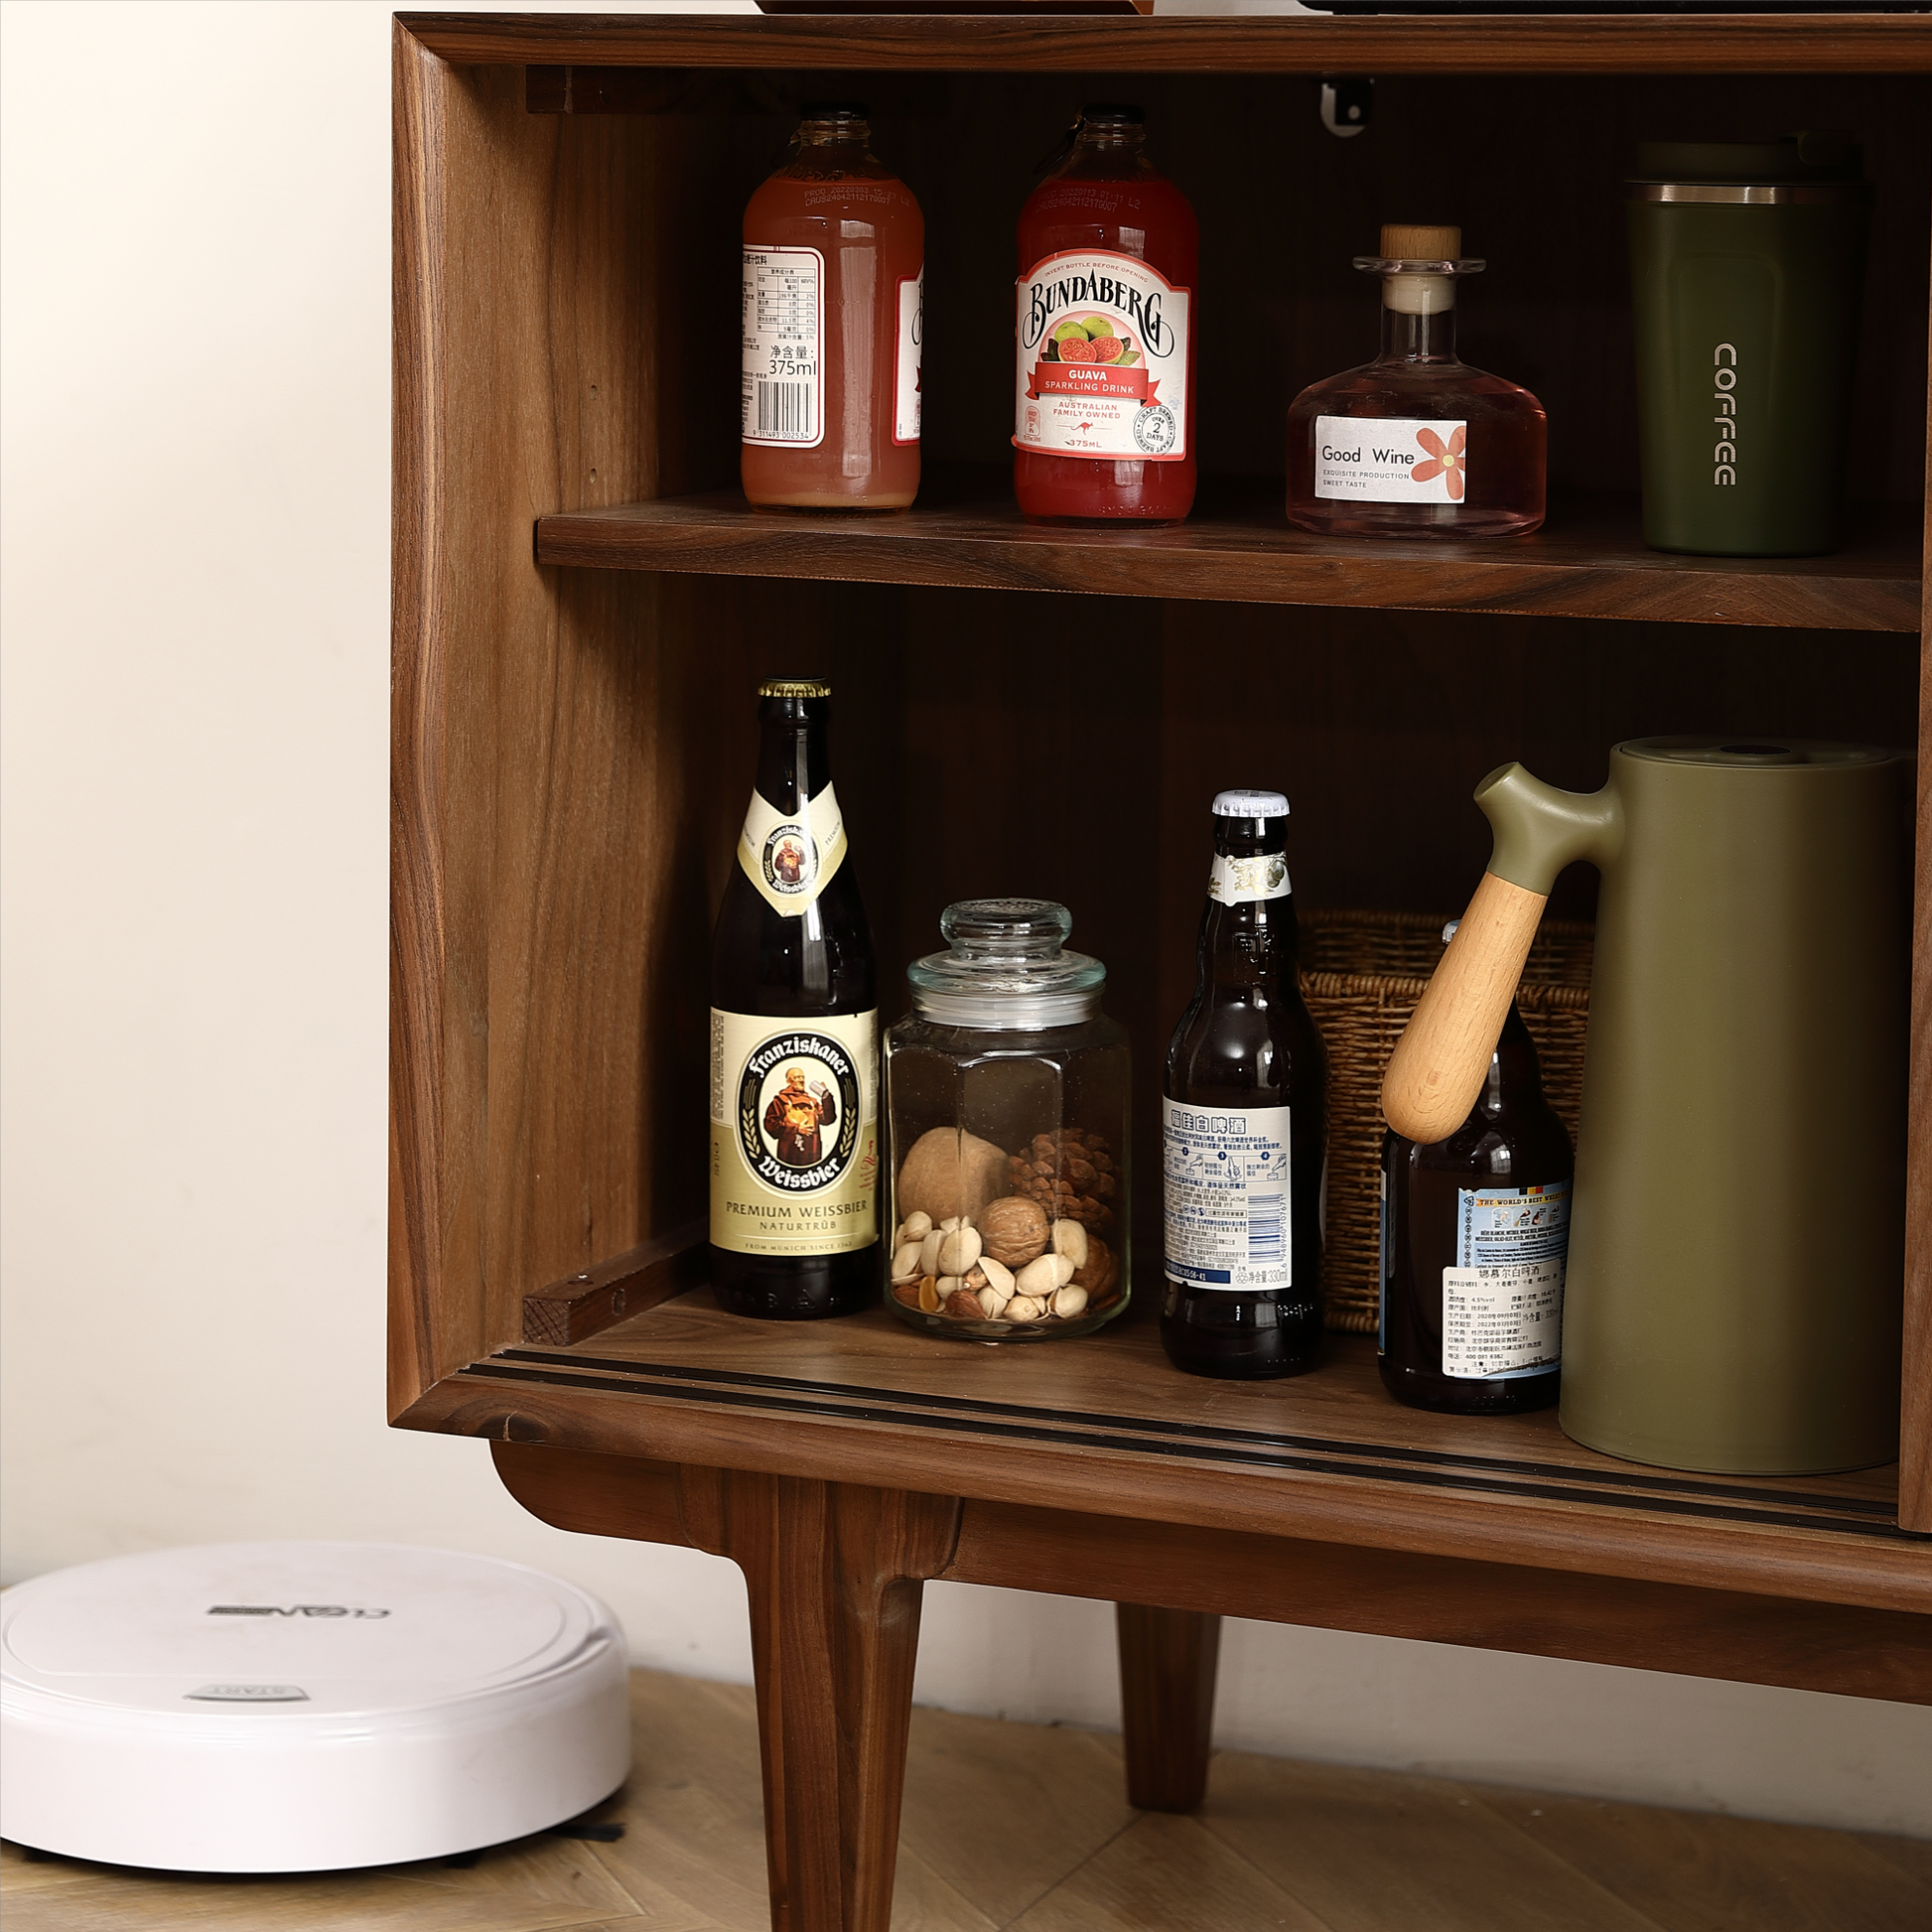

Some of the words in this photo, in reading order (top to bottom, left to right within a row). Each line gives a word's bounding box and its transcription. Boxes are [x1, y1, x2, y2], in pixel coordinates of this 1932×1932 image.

[1044, 264, 1064, 277] INVERT
[1092, 262, 1120, 273] BEFORE
[1121, 267, 1149, 283] OPENING
[1023, 268, 1175, 358] BUNDABERG
[769, 359, 817, 376] 375ml
[1068, 369, 1108, 382] GUAVA
[1044, 381, 1099, 392] SPARKLING
[1102, 384, 1135, 395] DRINK
[1052, 408, 1083, 418] FAMILY
[1086, 410, 1121, 420] OWNED
[1058, 401, 1118, 411] AUSTRALIAN
[1139, 407, 1157, 423] CRAFT
[1714, 343, 1737, 486] COFFEE
[1153, 422, 1162, 434] 2
[1146, 432, 1165, 443] DAYS
[1322, 445, 1361, 463] Good
[1372, 448, 1416, 466] Wine
[1323, 469, 1357, 478] EXQUISITE
[1359, 472, 1410, 481] PRODUCTION
[749, 1035, 850, 1078] Franziskaner
[758, 1155, 841, 1189] Weissbier
[726, 1201, 792, 1218] PREMIUM
[798, 1200, 869, 1218] WEISSBIER
[759, 1220, 837, 1231] NATURTRÜB
